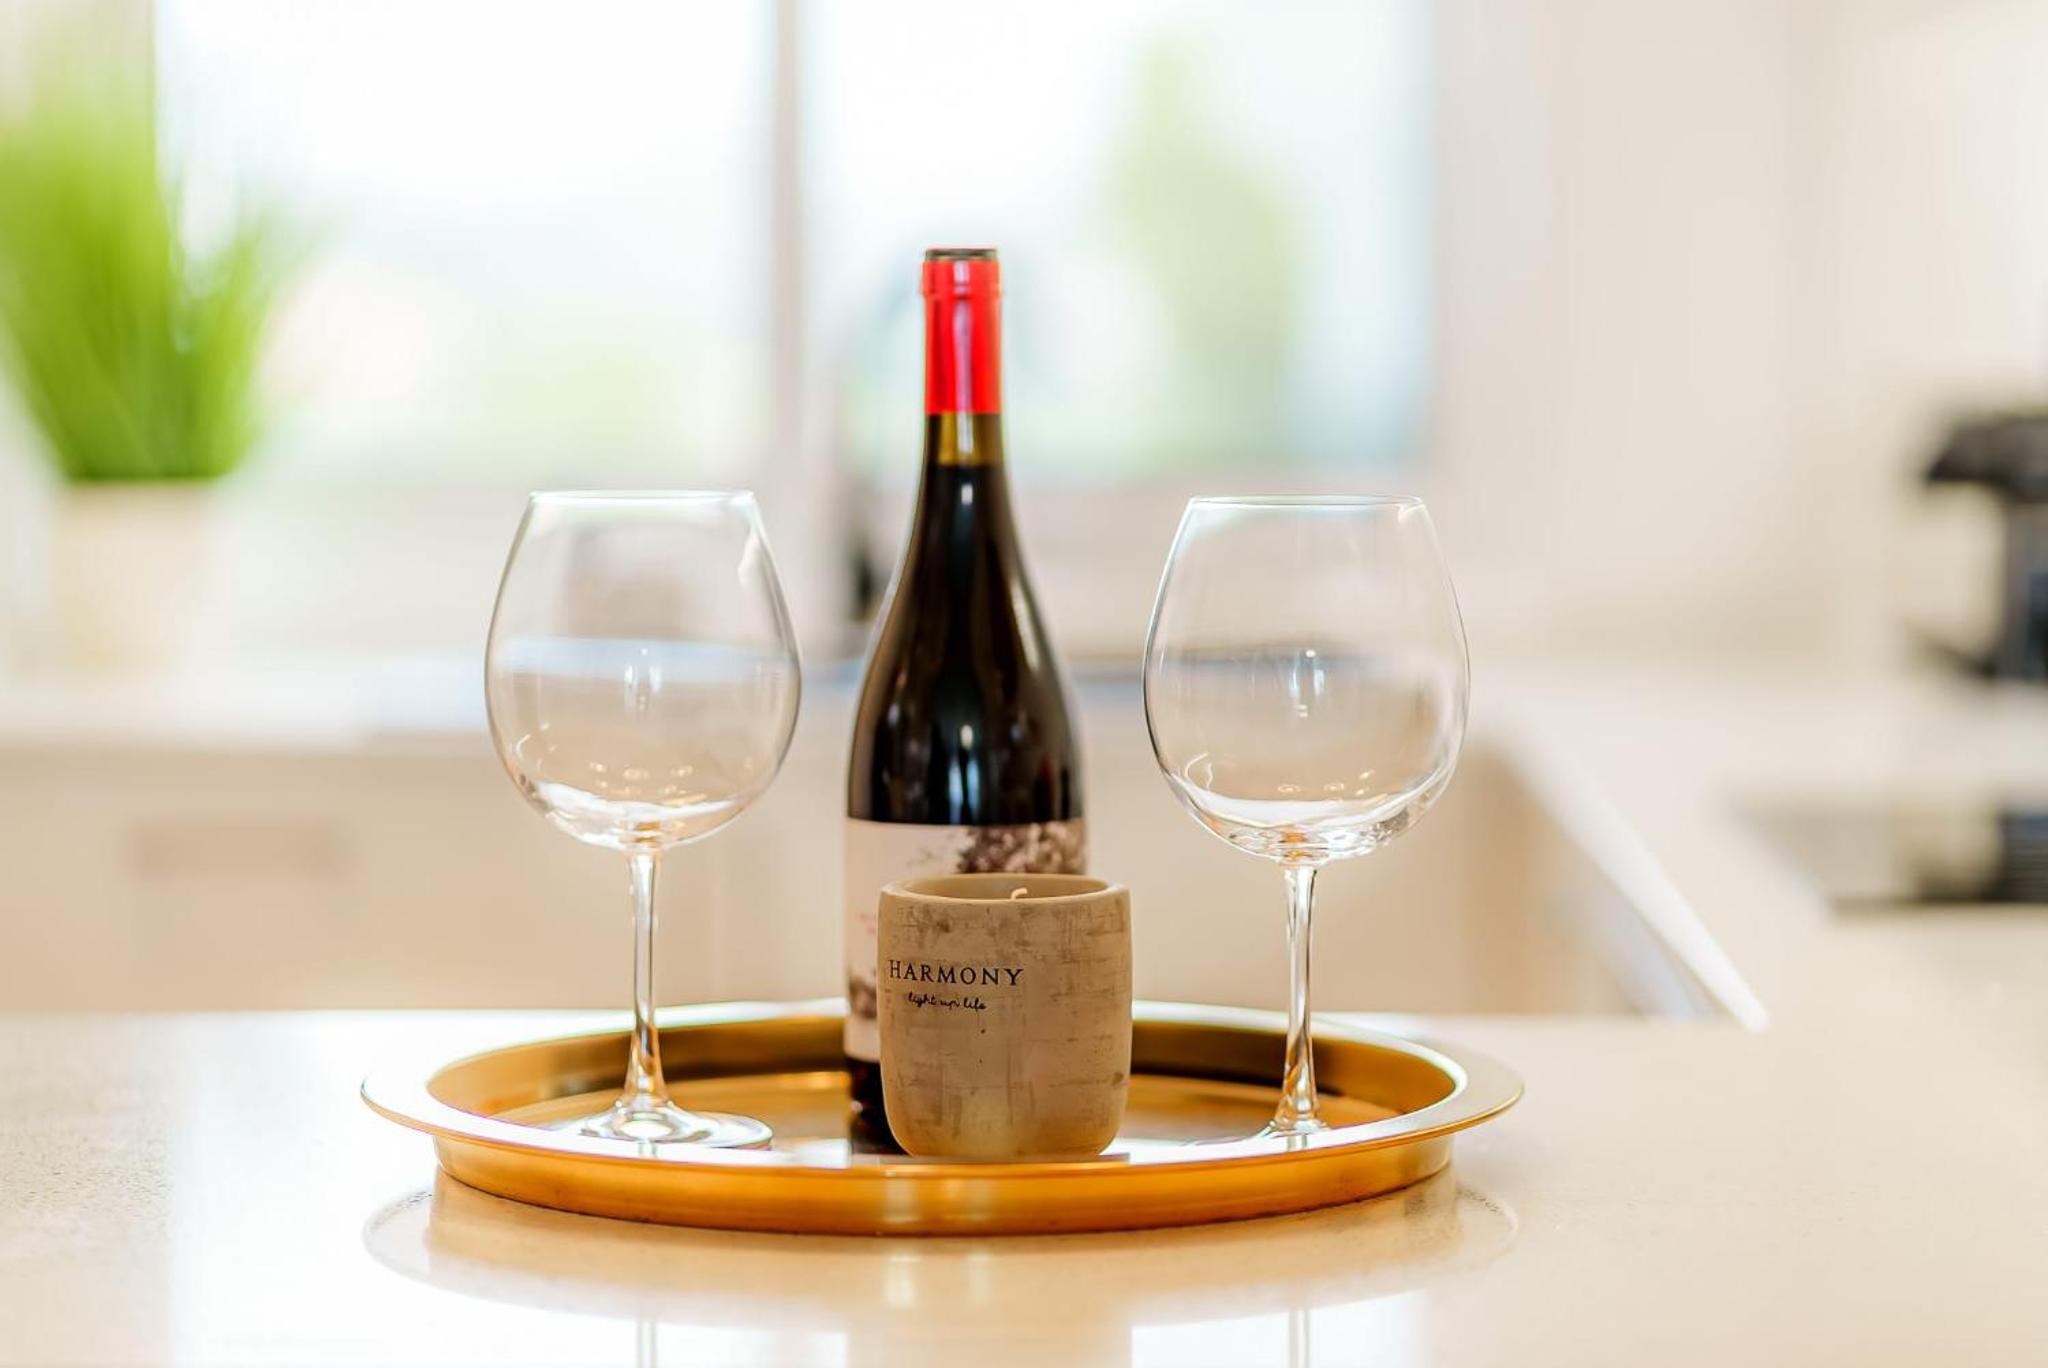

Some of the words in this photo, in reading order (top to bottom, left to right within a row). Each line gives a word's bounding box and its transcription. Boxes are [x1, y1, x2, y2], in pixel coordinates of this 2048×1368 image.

[888, 959, 1024, 986] HARMONY
[908, 991, 937, 1008] light
[940, 1000, 960, 1010] up
[963, 997, 987, 1012] life
